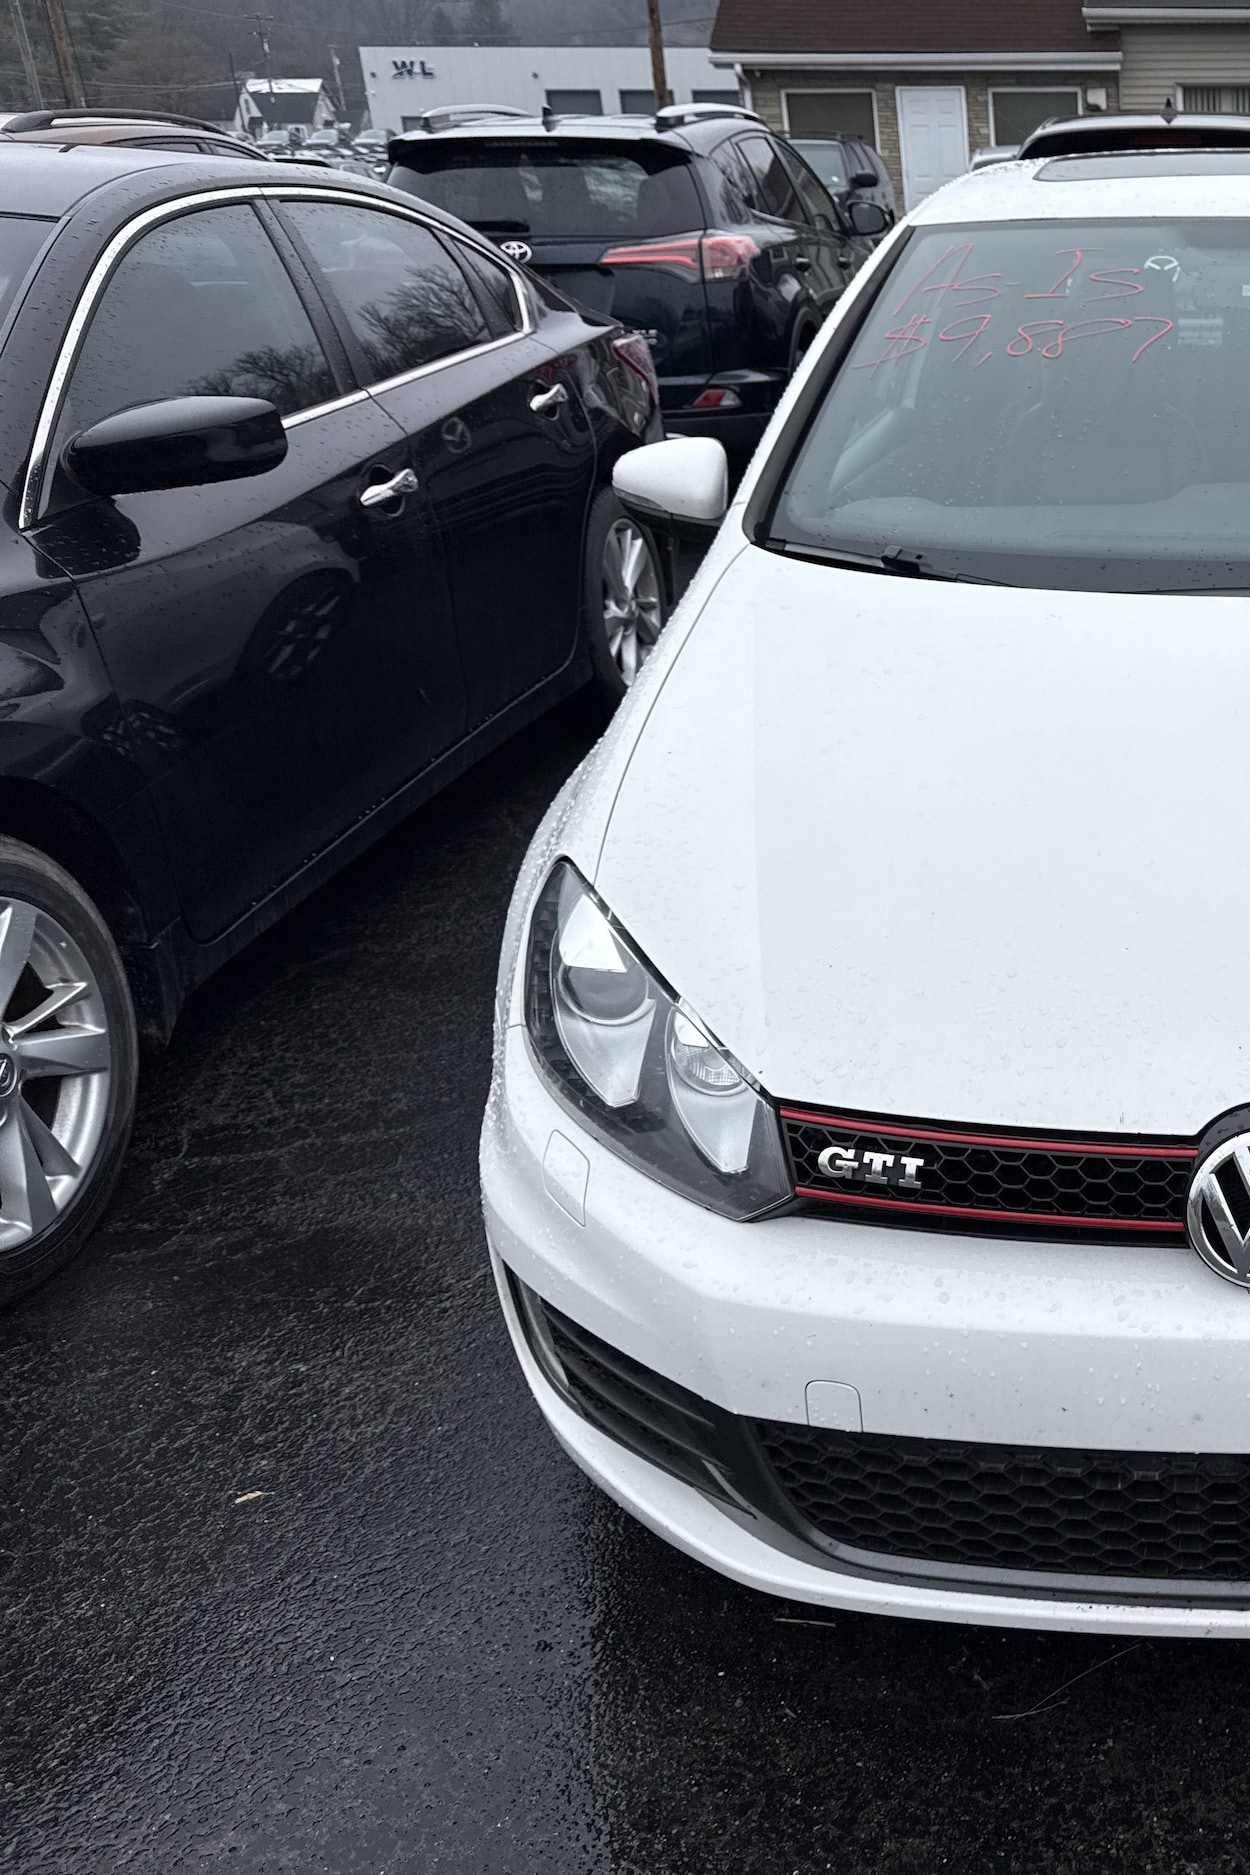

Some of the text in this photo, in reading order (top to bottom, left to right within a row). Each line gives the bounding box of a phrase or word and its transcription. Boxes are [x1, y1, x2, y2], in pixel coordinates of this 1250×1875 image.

[391, 60, 435, 78] WL
[851, 313, 1174, 380] $9,887
[818, 1146, 924, 1189] GTI
